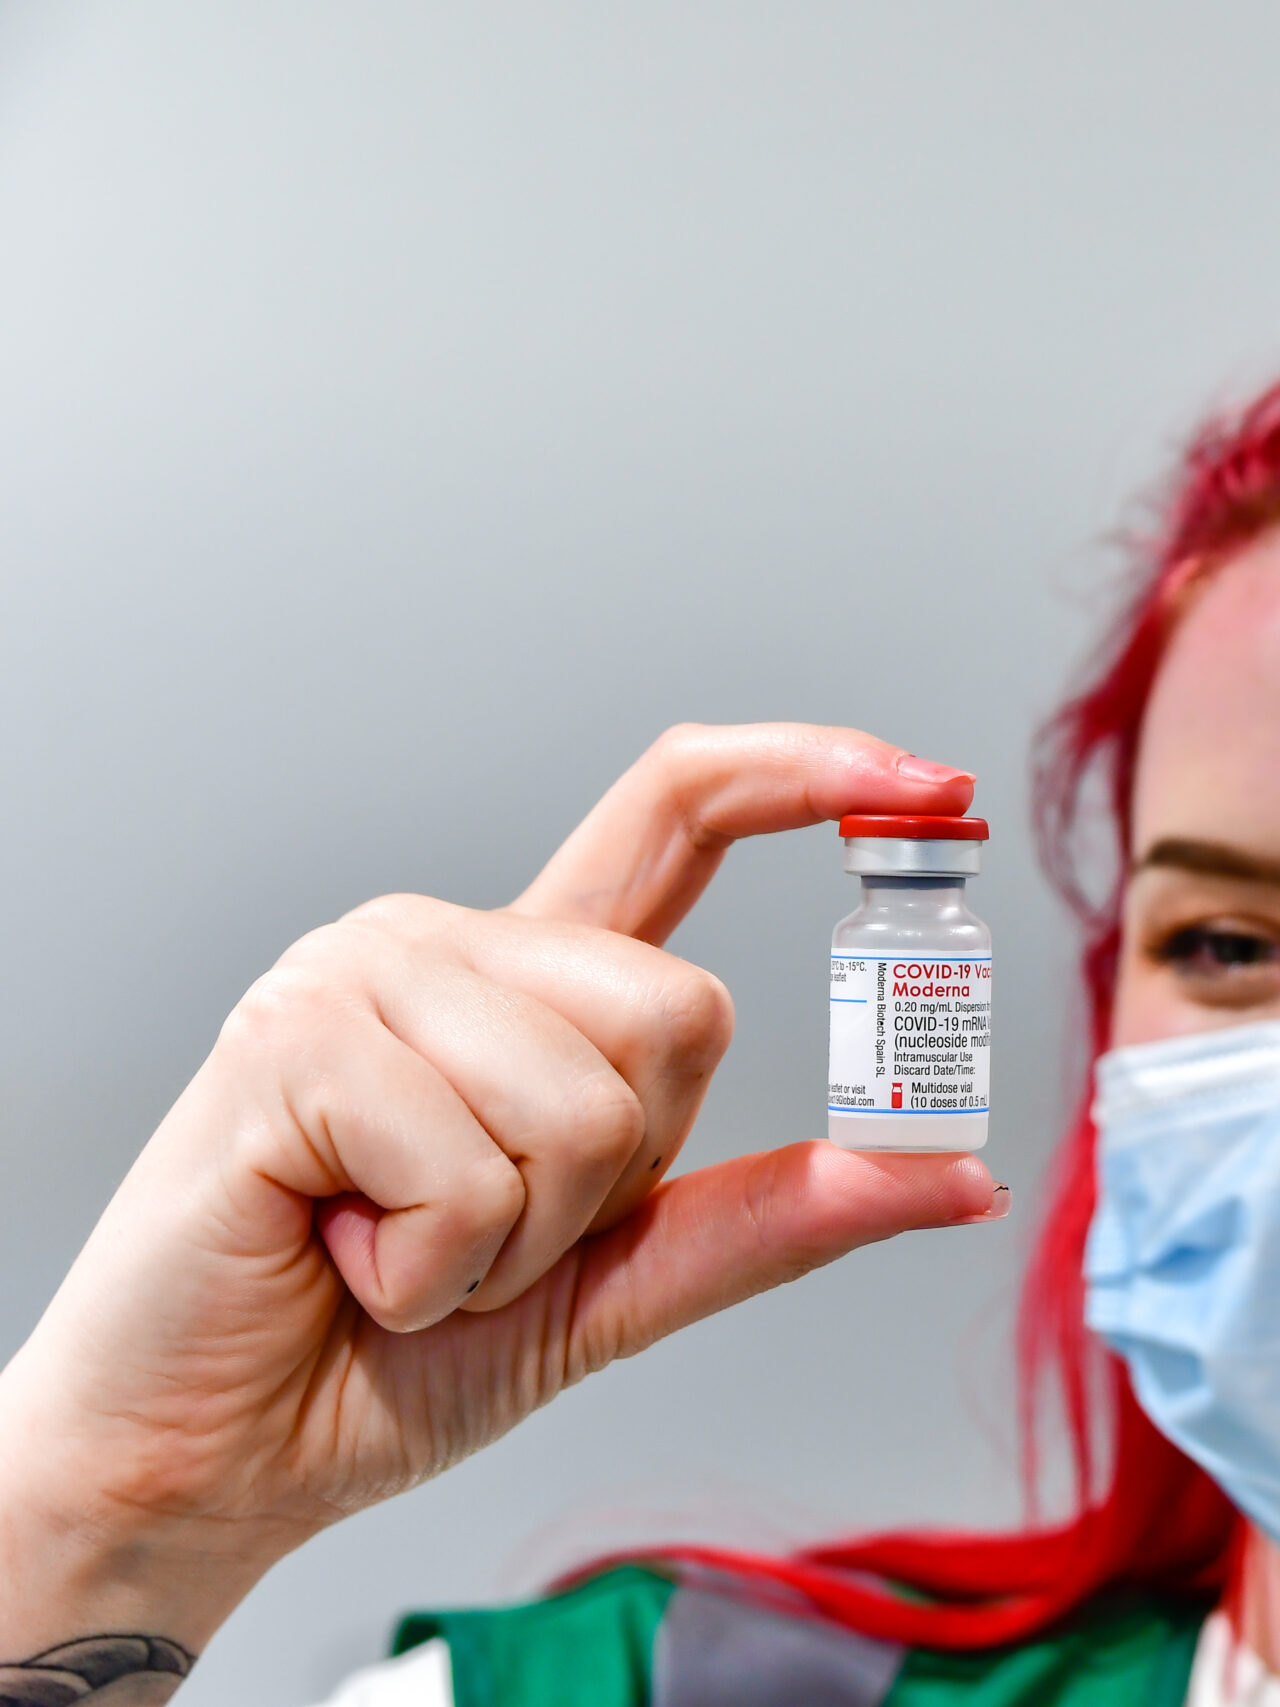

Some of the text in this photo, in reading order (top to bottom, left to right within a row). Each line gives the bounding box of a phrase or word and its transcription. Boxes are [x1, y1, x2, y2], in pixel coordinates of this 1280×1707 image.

[846, 961, 867, 972] -15°C.
[893, 963, 971, 979] COVID-19
[892, 982, 970, 997] Moderna
[894, 1001, 917, 1012] 0.20
[920, 1001, 953, 1014] mg/mL
[875, 962, 887, 1078] Moderna Biotech Spain SL
[894, 1016, 959, 1031] COVID-19
[962, 1016, 986, 1031] mRNA
[894, 1033, 968, 1050] (nucleoside
[894, 1052, 973, 1062] Intramuscular Use
[894, 1064, 976, 1076] Discard Date/Time:
[852, 1084, 866, 1094] visit
[911, 1082, 973, 1094] Multidose vial
[911, 1095, 927, 1109] (10
[930, 1096, 957, 1108] doses
[959, 1096, 968, 1107] of
[968, 1095, 979, 1107] 0.5
